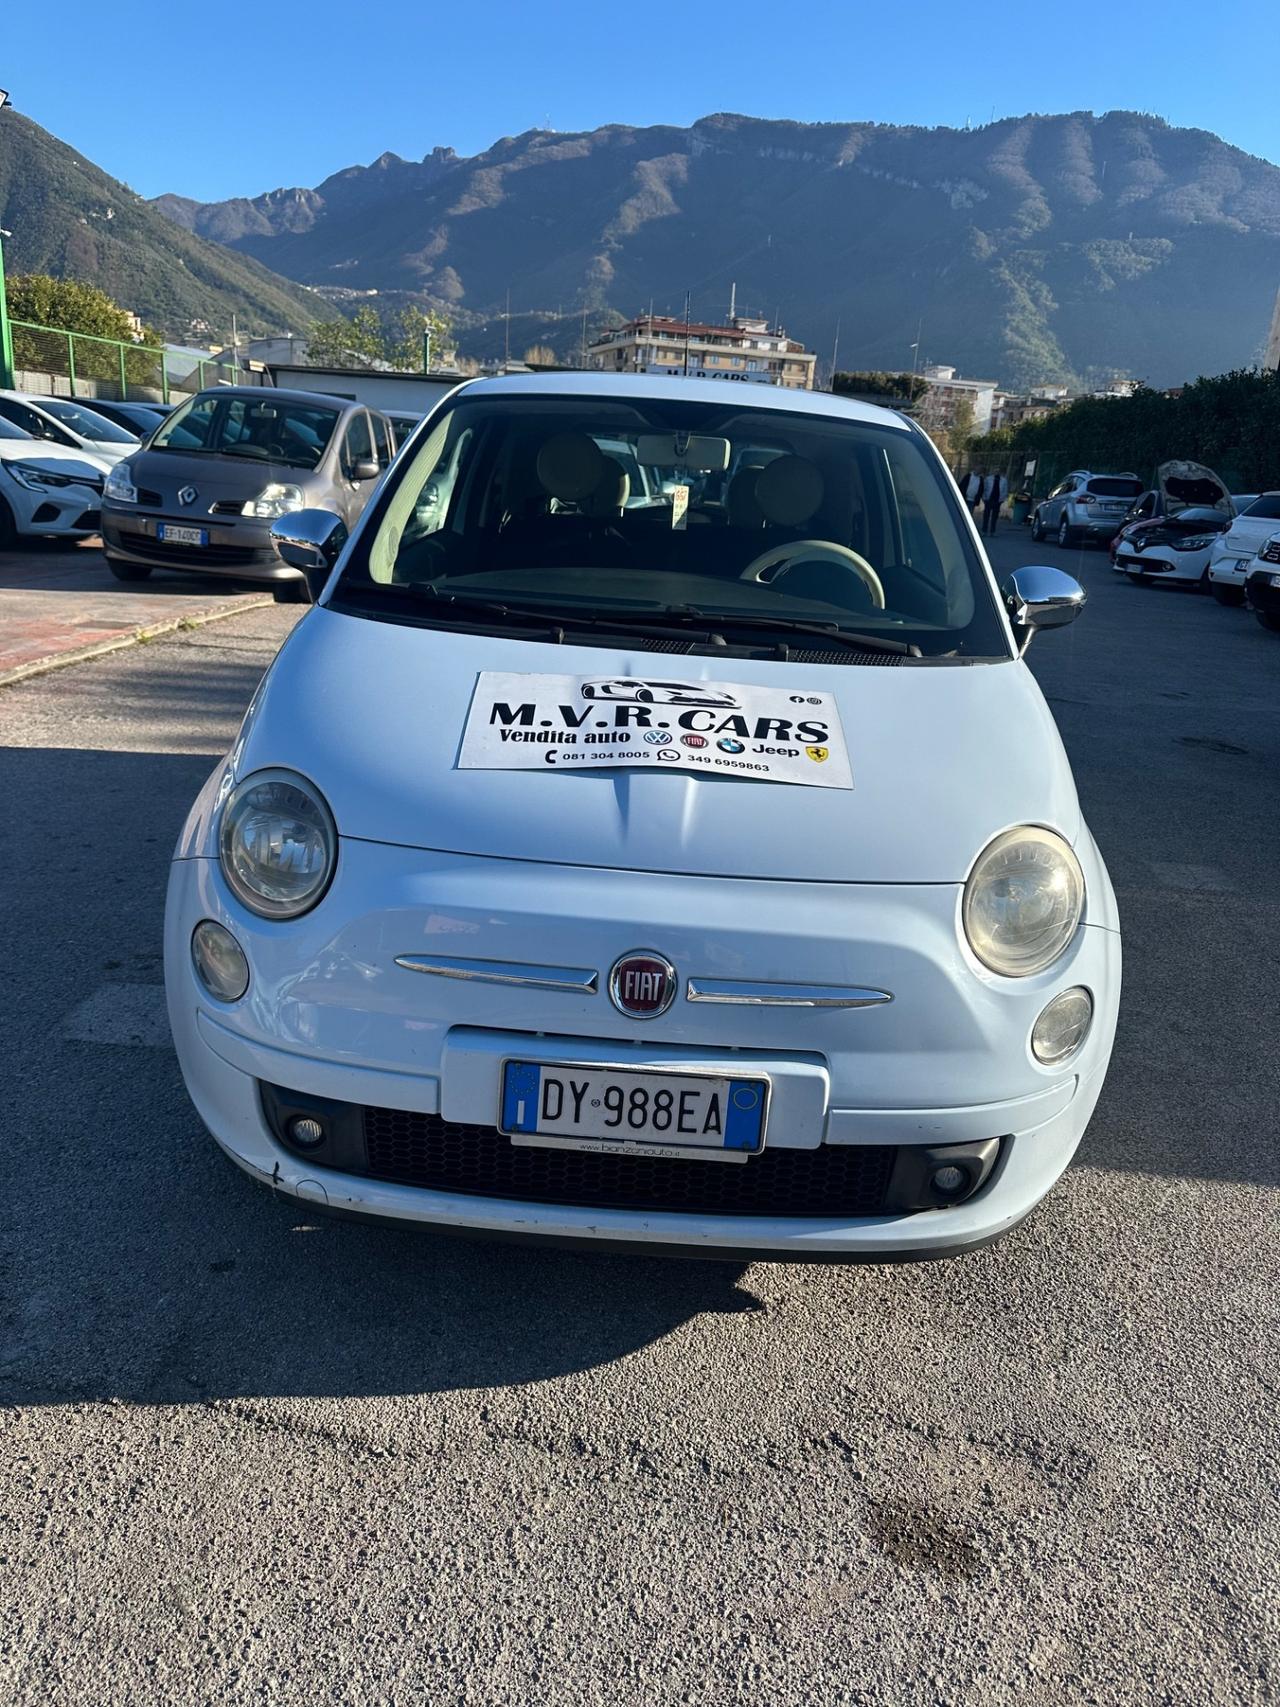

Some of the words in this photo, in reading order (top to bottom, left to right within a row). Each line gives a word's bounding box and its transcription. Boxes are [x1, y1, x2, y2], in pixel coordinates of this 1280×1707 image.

[500, 729, 577, 744] Vendita
[584, 731, 631, 744] auto
[591, 752, 614, 760] 304
[618, 751, 650, 759] 8005
[752, 744, 800, 758] Jeep
[687, 754, 711, 763] 349
[715, 758, 770, 772] 6959863
[625, 970, 663, 1001] FIAT
